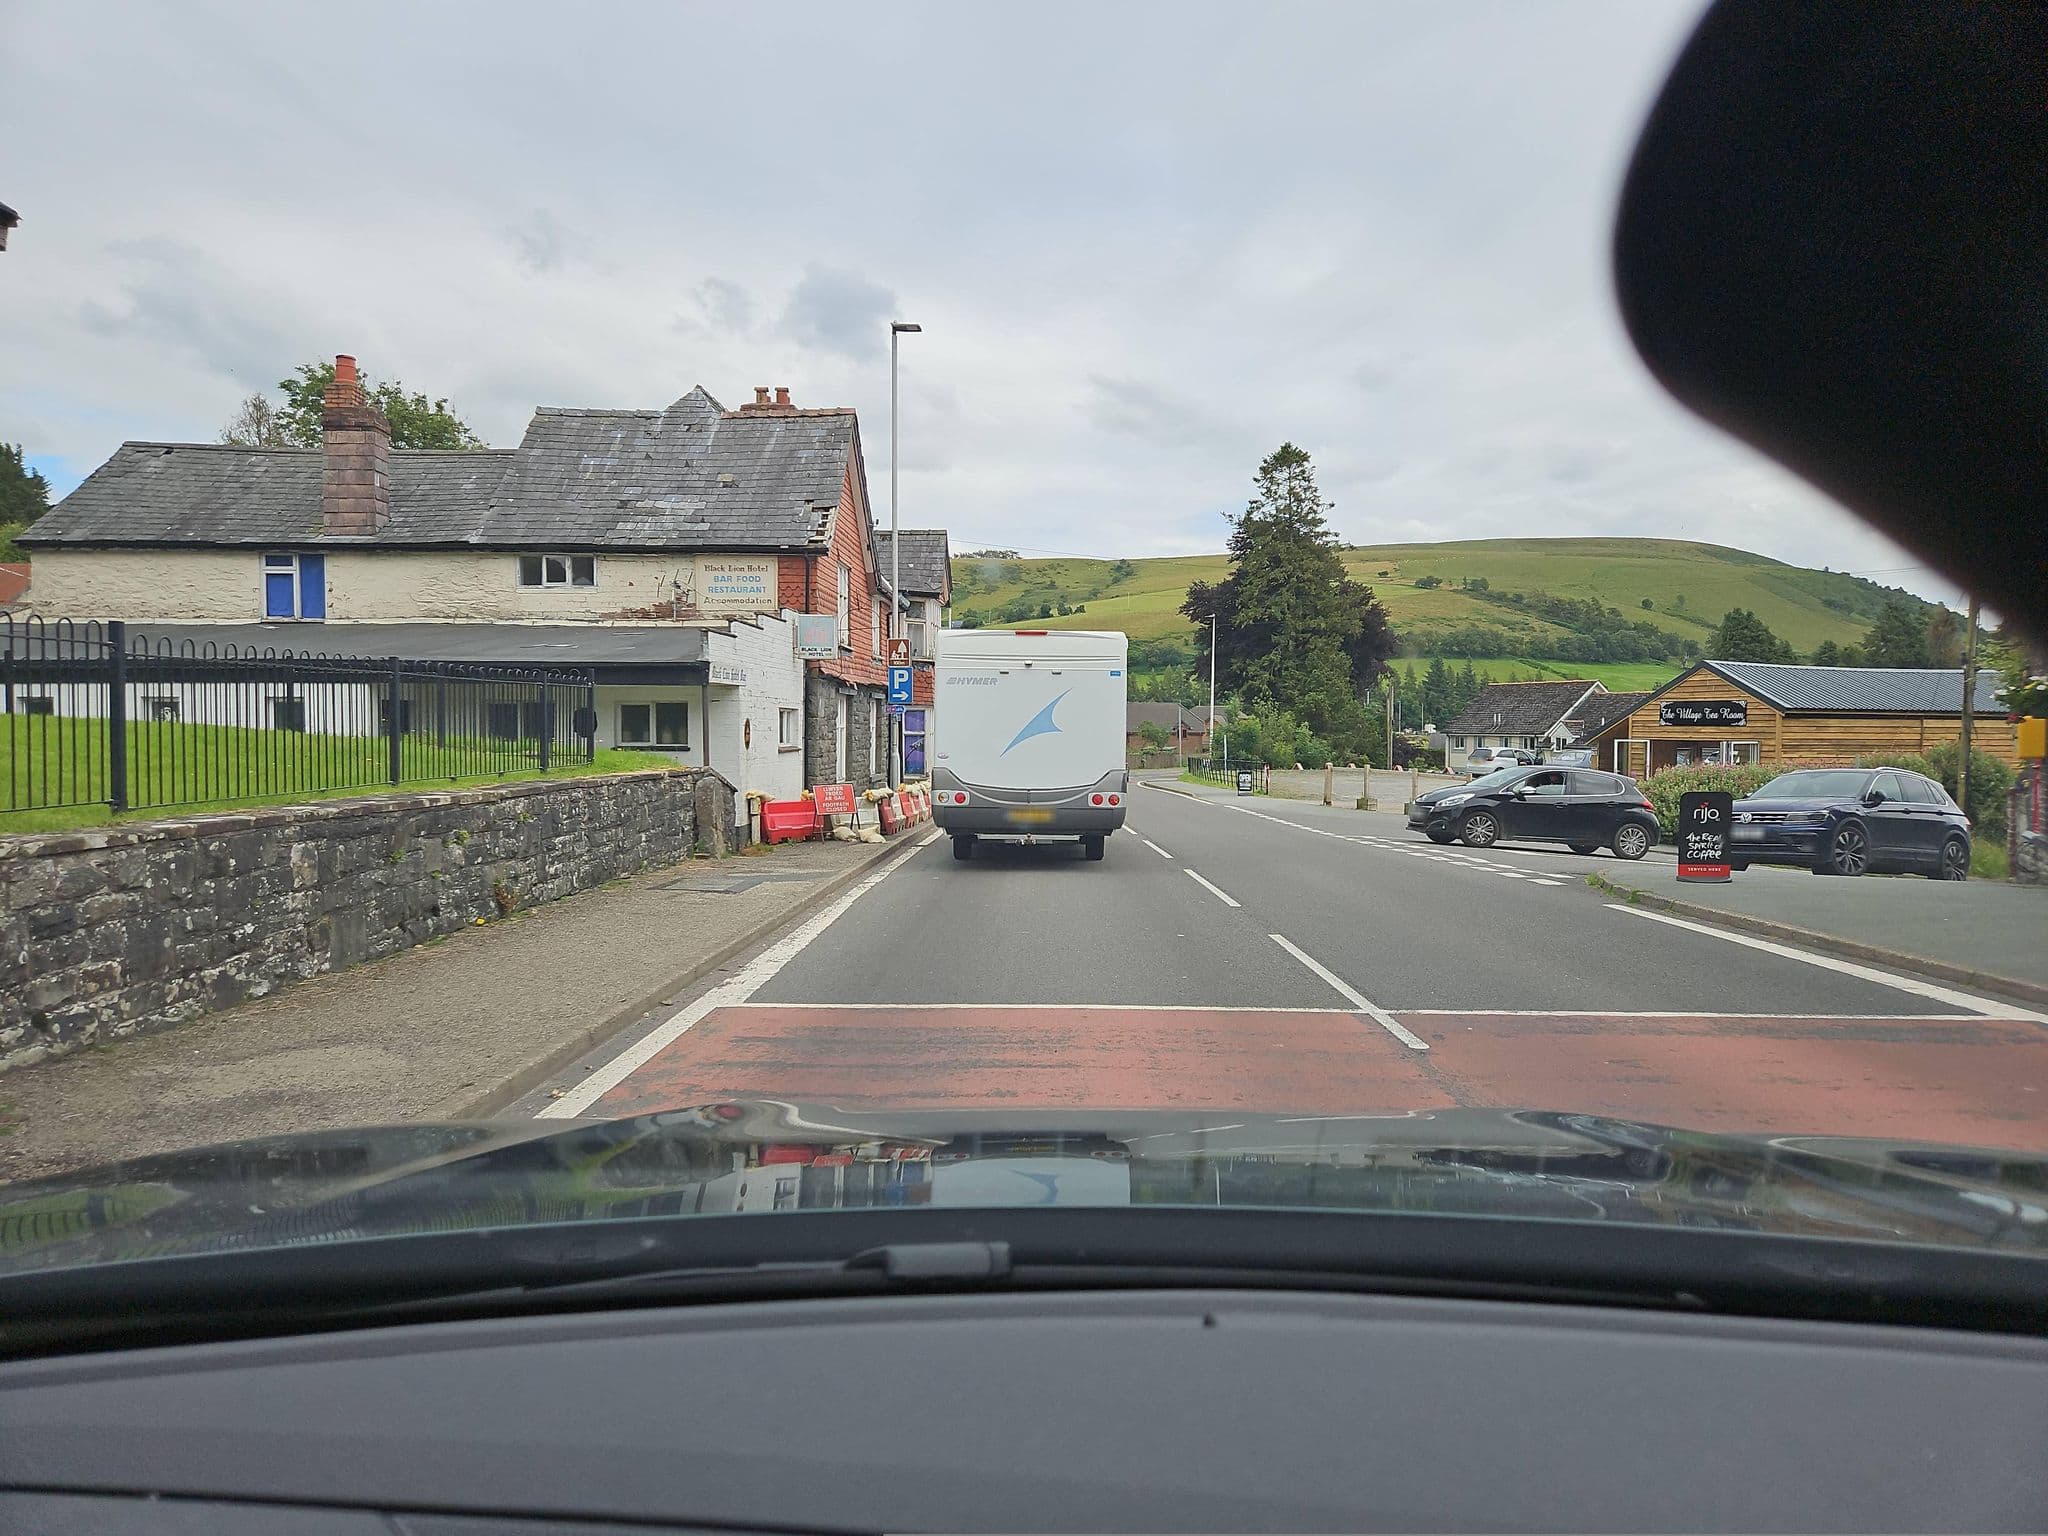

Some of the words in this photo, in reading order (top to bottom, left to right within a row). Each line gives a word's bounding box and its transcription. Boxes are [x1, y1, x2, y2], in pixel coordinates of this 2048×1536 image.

[704, 564, 726, 572] Black
[747, 564, 769, 572] Hotel
[713, 575, 733, 583] BAR
[736, 575, 761, 583] FOOD
[708, 586, 767, 594] RESTAURANT
[703, 597, 772, 605] Accommodation
[894, 670, 909, 690] P
[956, 677, 998, 686] HYMER
[1662, 708, 1675, 720] The
[1676, 708, 1703, 722] Village
[1704, 708, 1719, 720] Tea
[1720, 708, 1745, 719] Room
[1693, 803, 1720, 824] rijo
